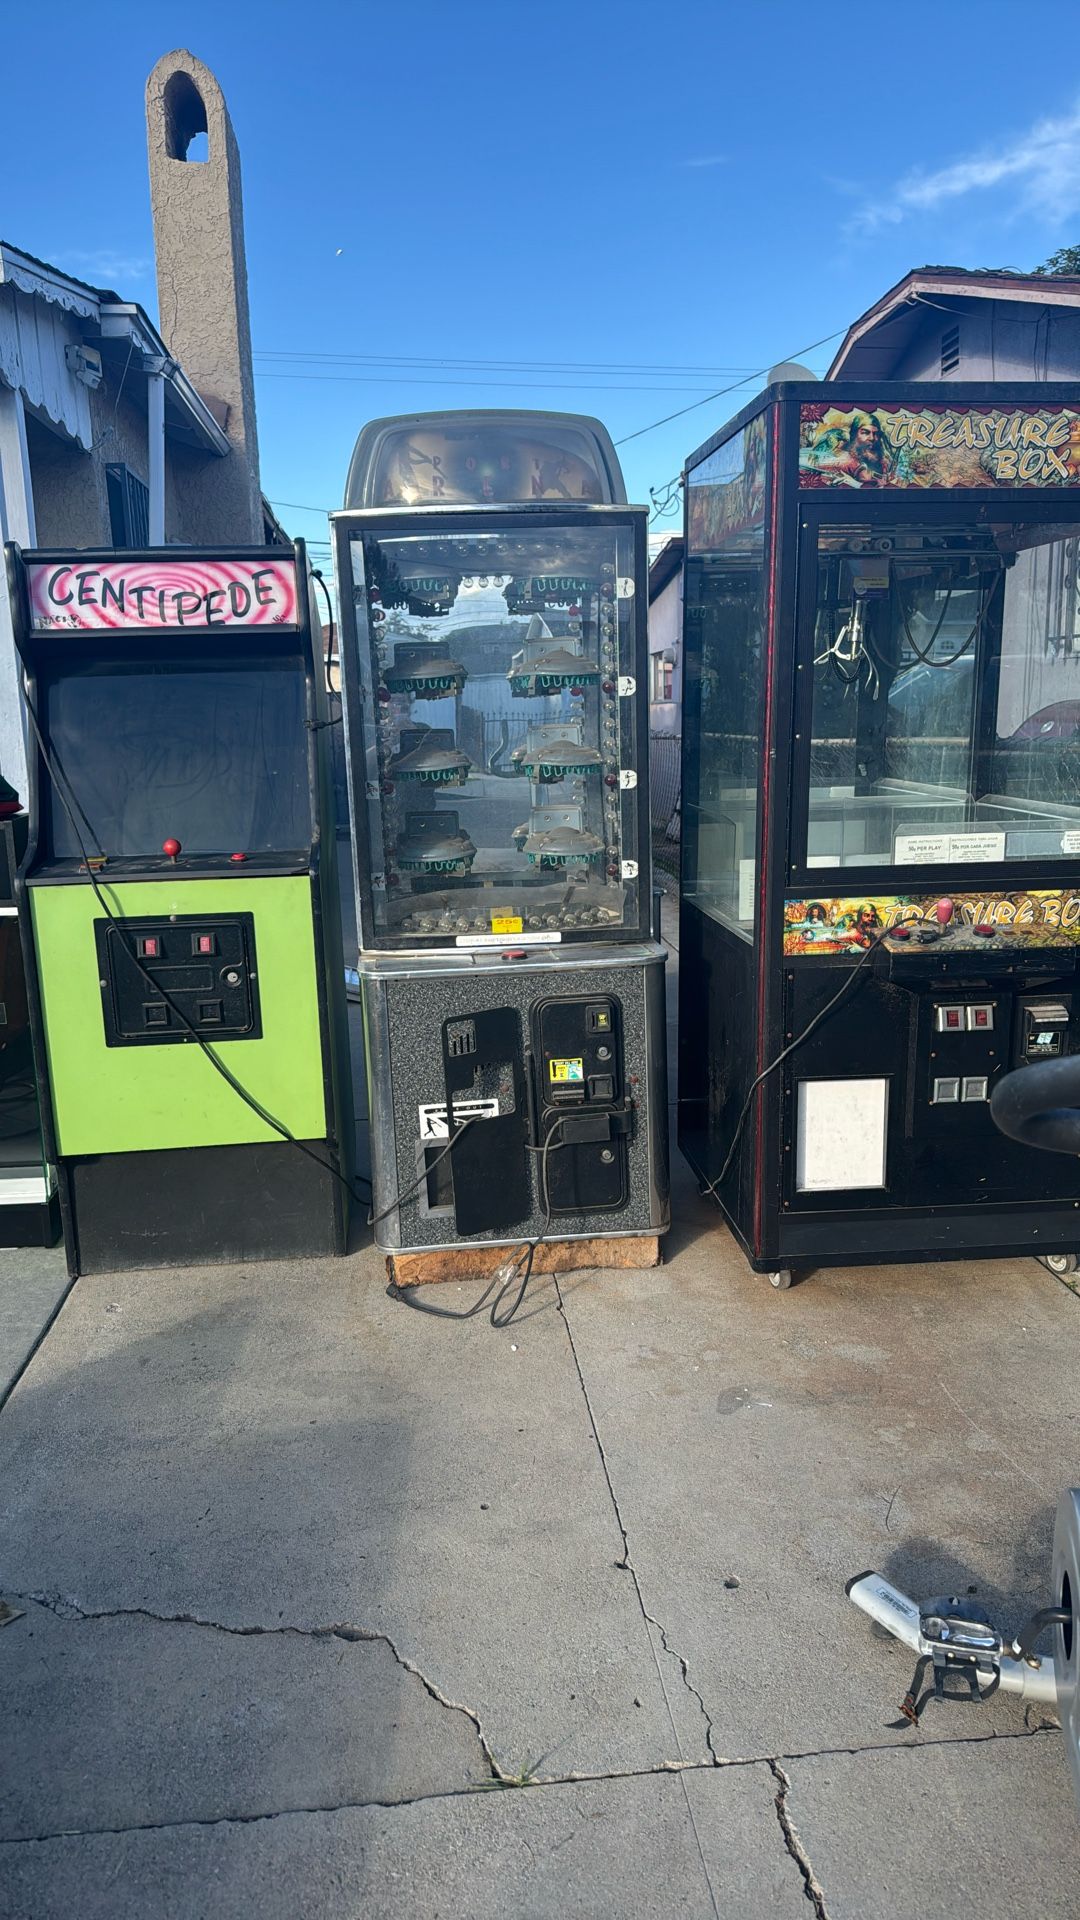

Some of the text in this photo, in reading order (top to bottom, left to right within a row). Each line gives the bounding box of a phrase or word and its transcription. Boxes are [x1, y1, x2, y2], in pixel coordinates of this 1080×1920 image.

[887, 415, 1070, 449] TREASURE
[992, 448, 1070, 480] BOX
[48, 566, 278, 627] CENTIPEDE
[885, 900, 1034, 927] TRESURE
